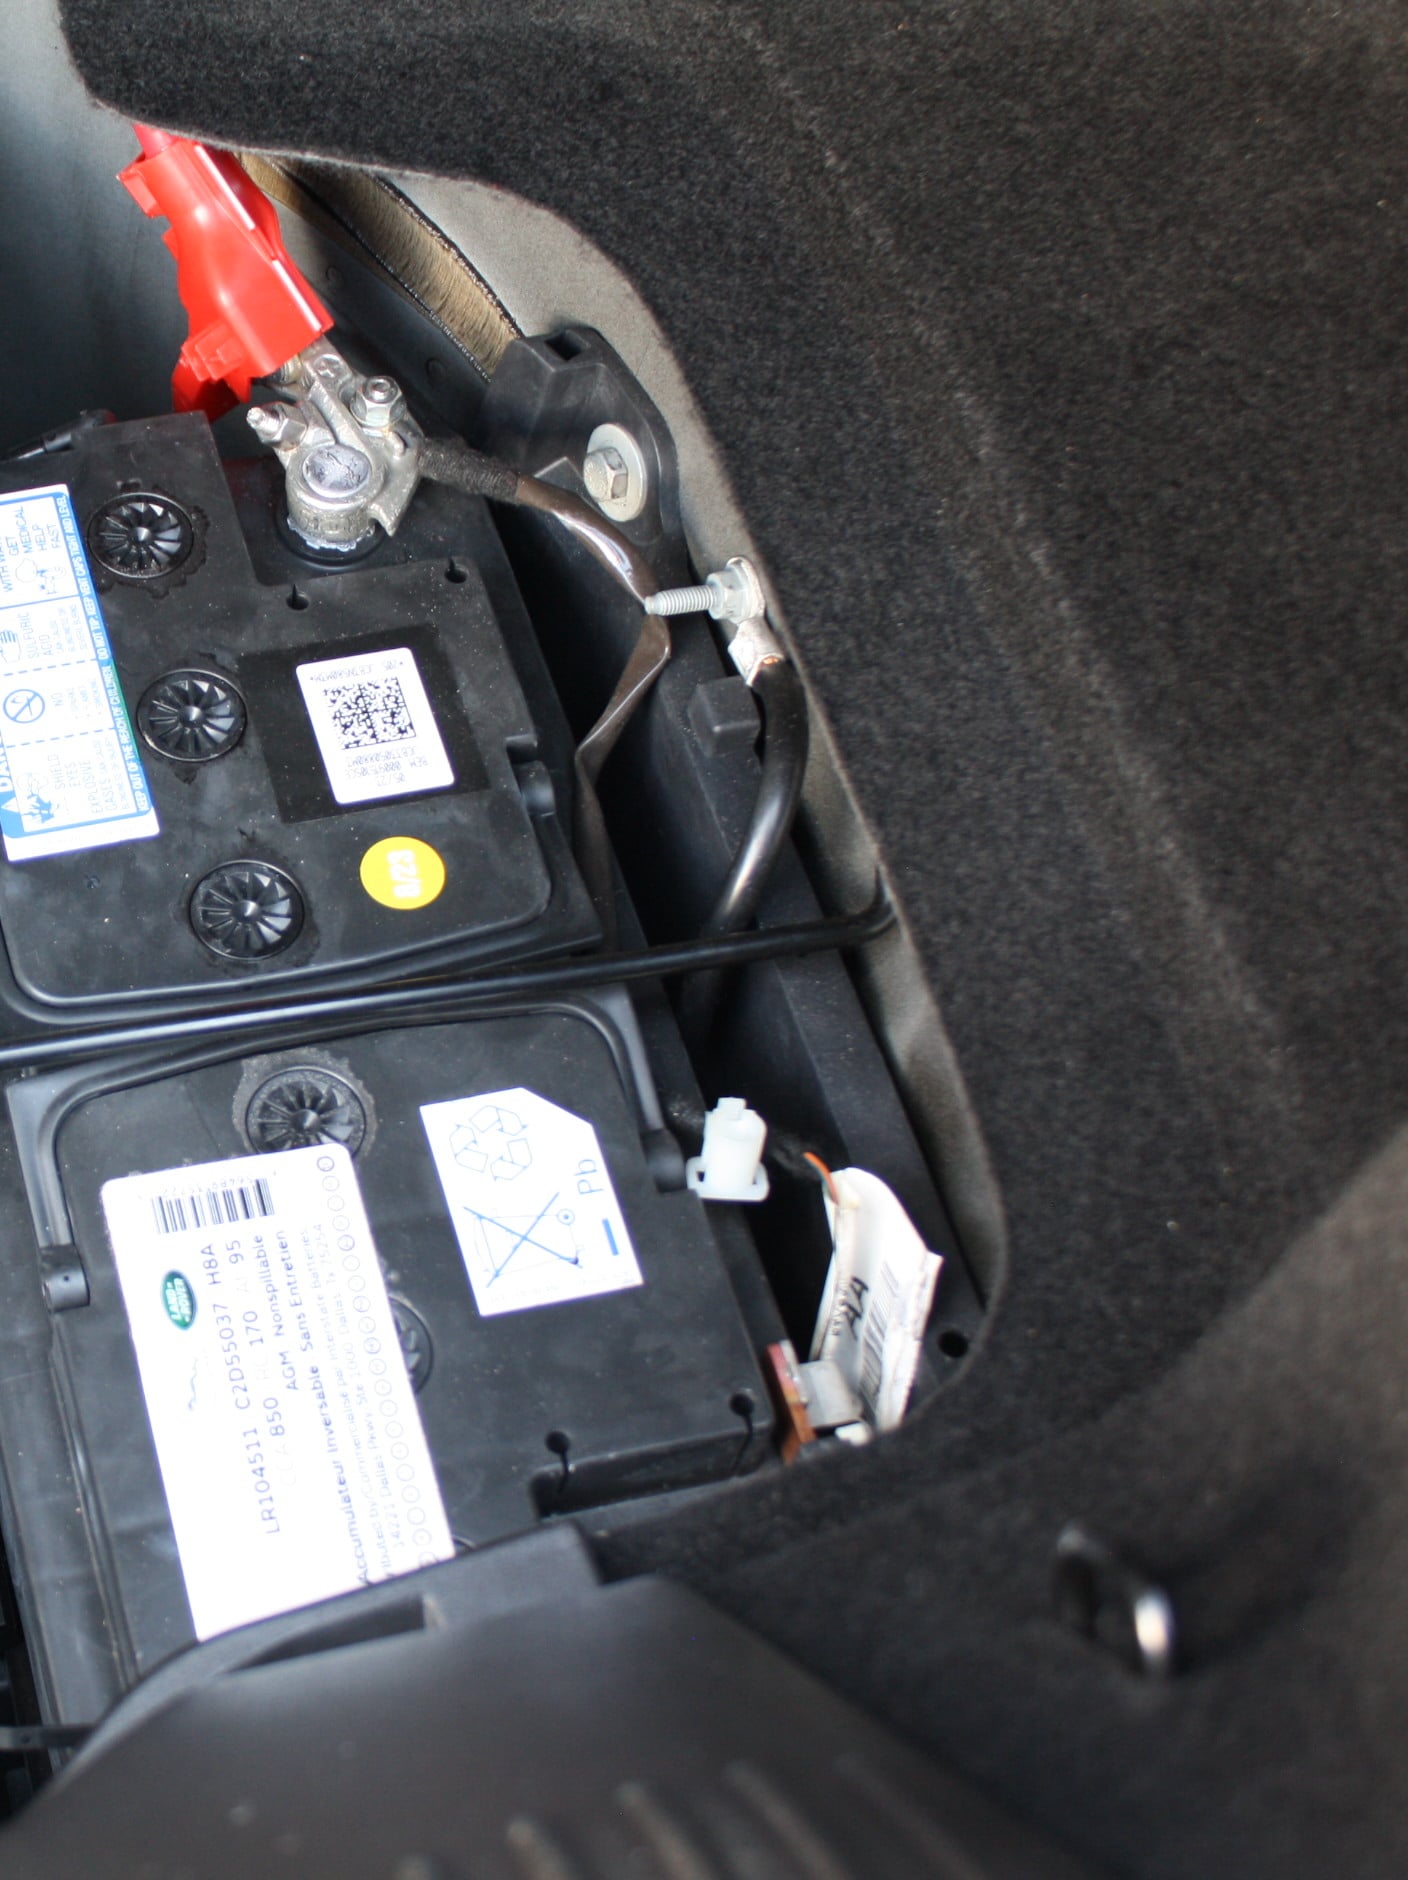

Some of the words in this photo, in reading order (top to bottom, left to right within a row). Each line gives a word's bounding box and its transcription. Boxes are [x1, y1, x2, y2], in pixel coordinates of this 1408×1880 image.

[15, 507, 32, 553] MEDICAL
[32, 524, 46, 551] HELP
[46, 524, 60, 548] FAST
[61, 517, 74, 534] AND
[5, 536, 19, 556] GET
[66, 534, 80, 555] TIGHT
[0, 565, 13, 591] WITH
[72, 556, 85, 576] CAPS
[77, 576, 91, 595] VENT
[83, 595, 96, 615] KEEP
[18, 613, 39, 658] SULFURIC
[39, 634, 53, 656] ACID
[51, 693, 63, 706] NO
[122, 743, 134, 759] THE
[47, 754, 66, 789] SHIELD
[64, 762, 81, 787] EYES
[126, 759, 137, 772] OF
[80, 761, 103, 813] EXPLOSIVE
[130, 773, 142, 789] OUT
[133, 789, 148, 811] KEEP
[575, 1158, 602, 1195] Pb
[201, 1245, 220, 1285] H8A
[226, 1240, 244, 1264] 95
[277, 1232, 302, 1307] Entretien
[253, 1236, 283, 1336] Nonspillable
[242, 1310, 264, 1345] 170
[296, 1312, 313, 1351] Sans
[212, 1304, 250, 1409] C2D55037
[279, 1351, 298, 1390] AGM
[263, 1397, 285, 1436] 850
[309, 1366, 336, 1452] Inversable
[243, 1428, 279, 1533] LR104511
[334, 1461, 369, 1582] Accumulateur
